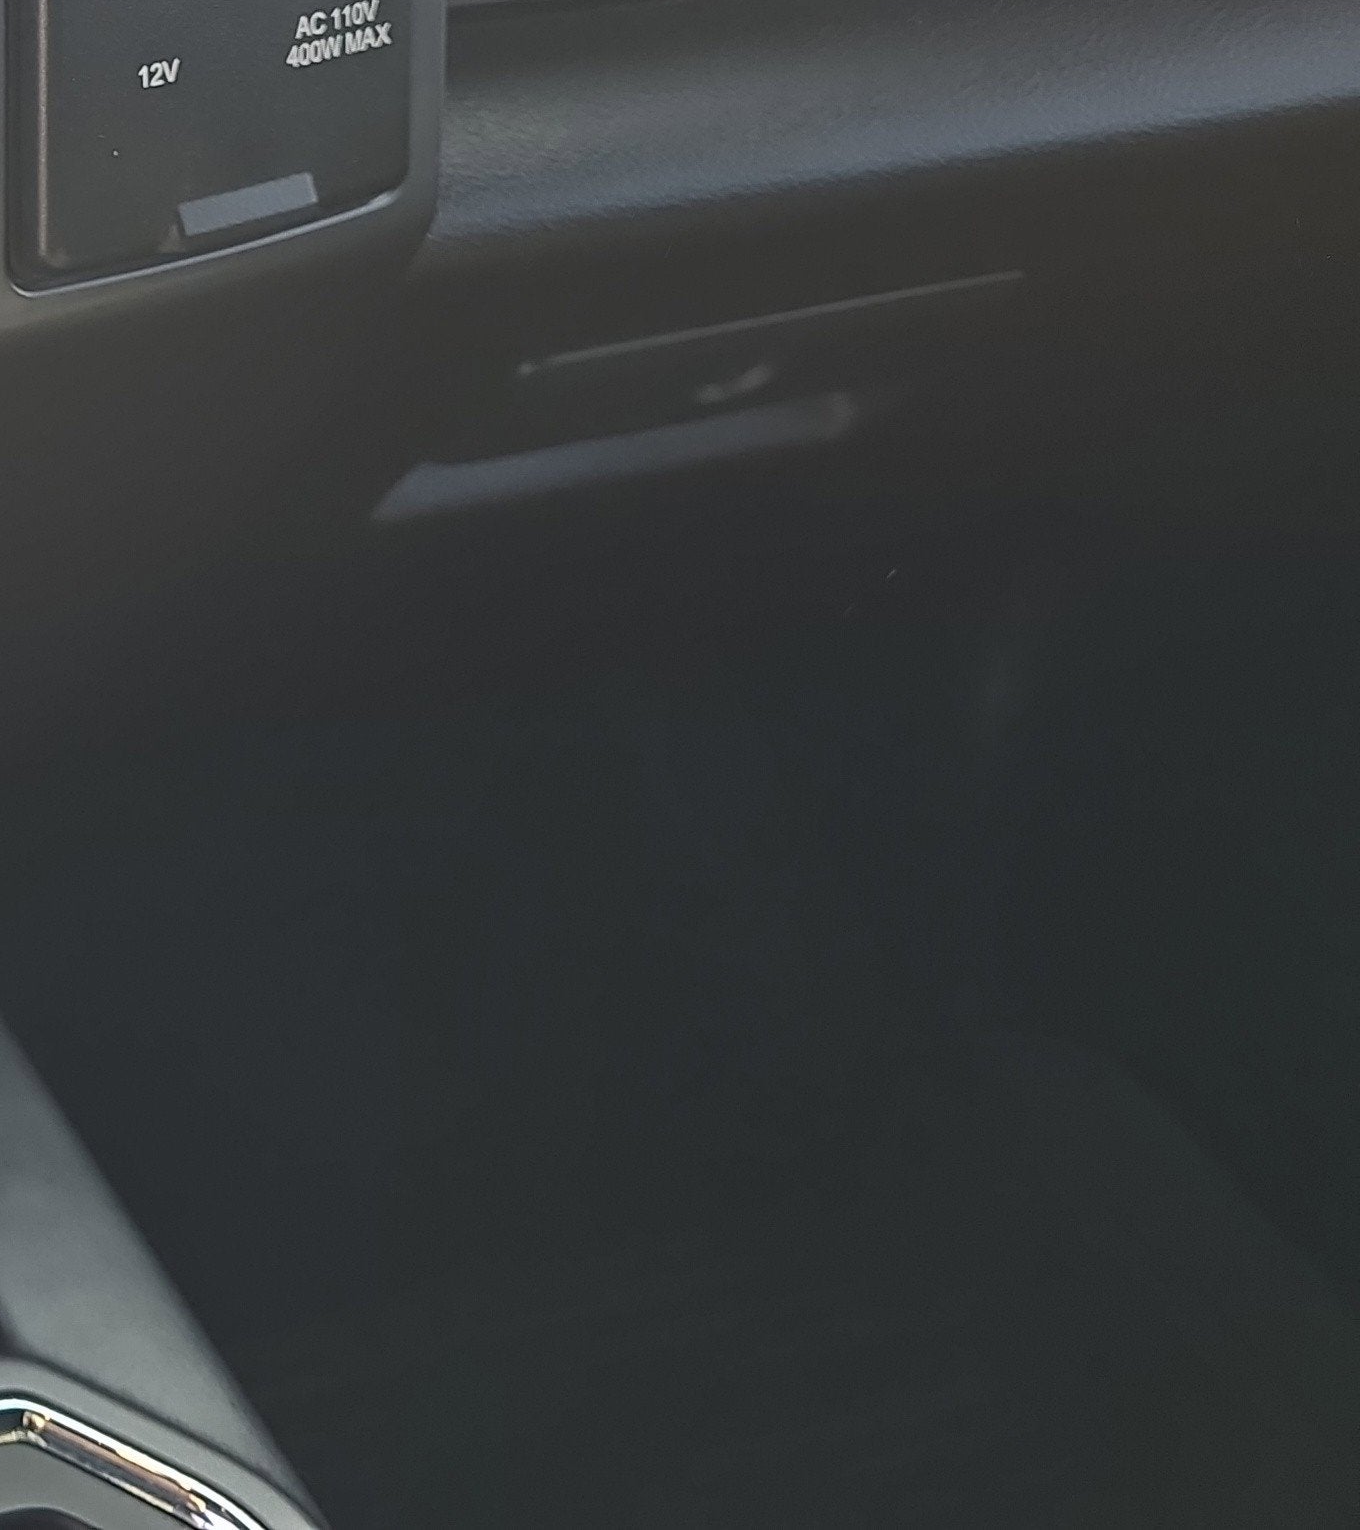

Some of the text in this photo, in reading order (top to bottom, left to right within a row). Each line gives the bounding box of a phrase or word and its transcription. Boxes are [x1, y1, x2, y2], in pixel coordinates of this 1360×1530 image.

[295, 10, 328, 40] AC
[286, 22, 393, 68] 400W MAX
[138, 58, 180, 89] 12V
